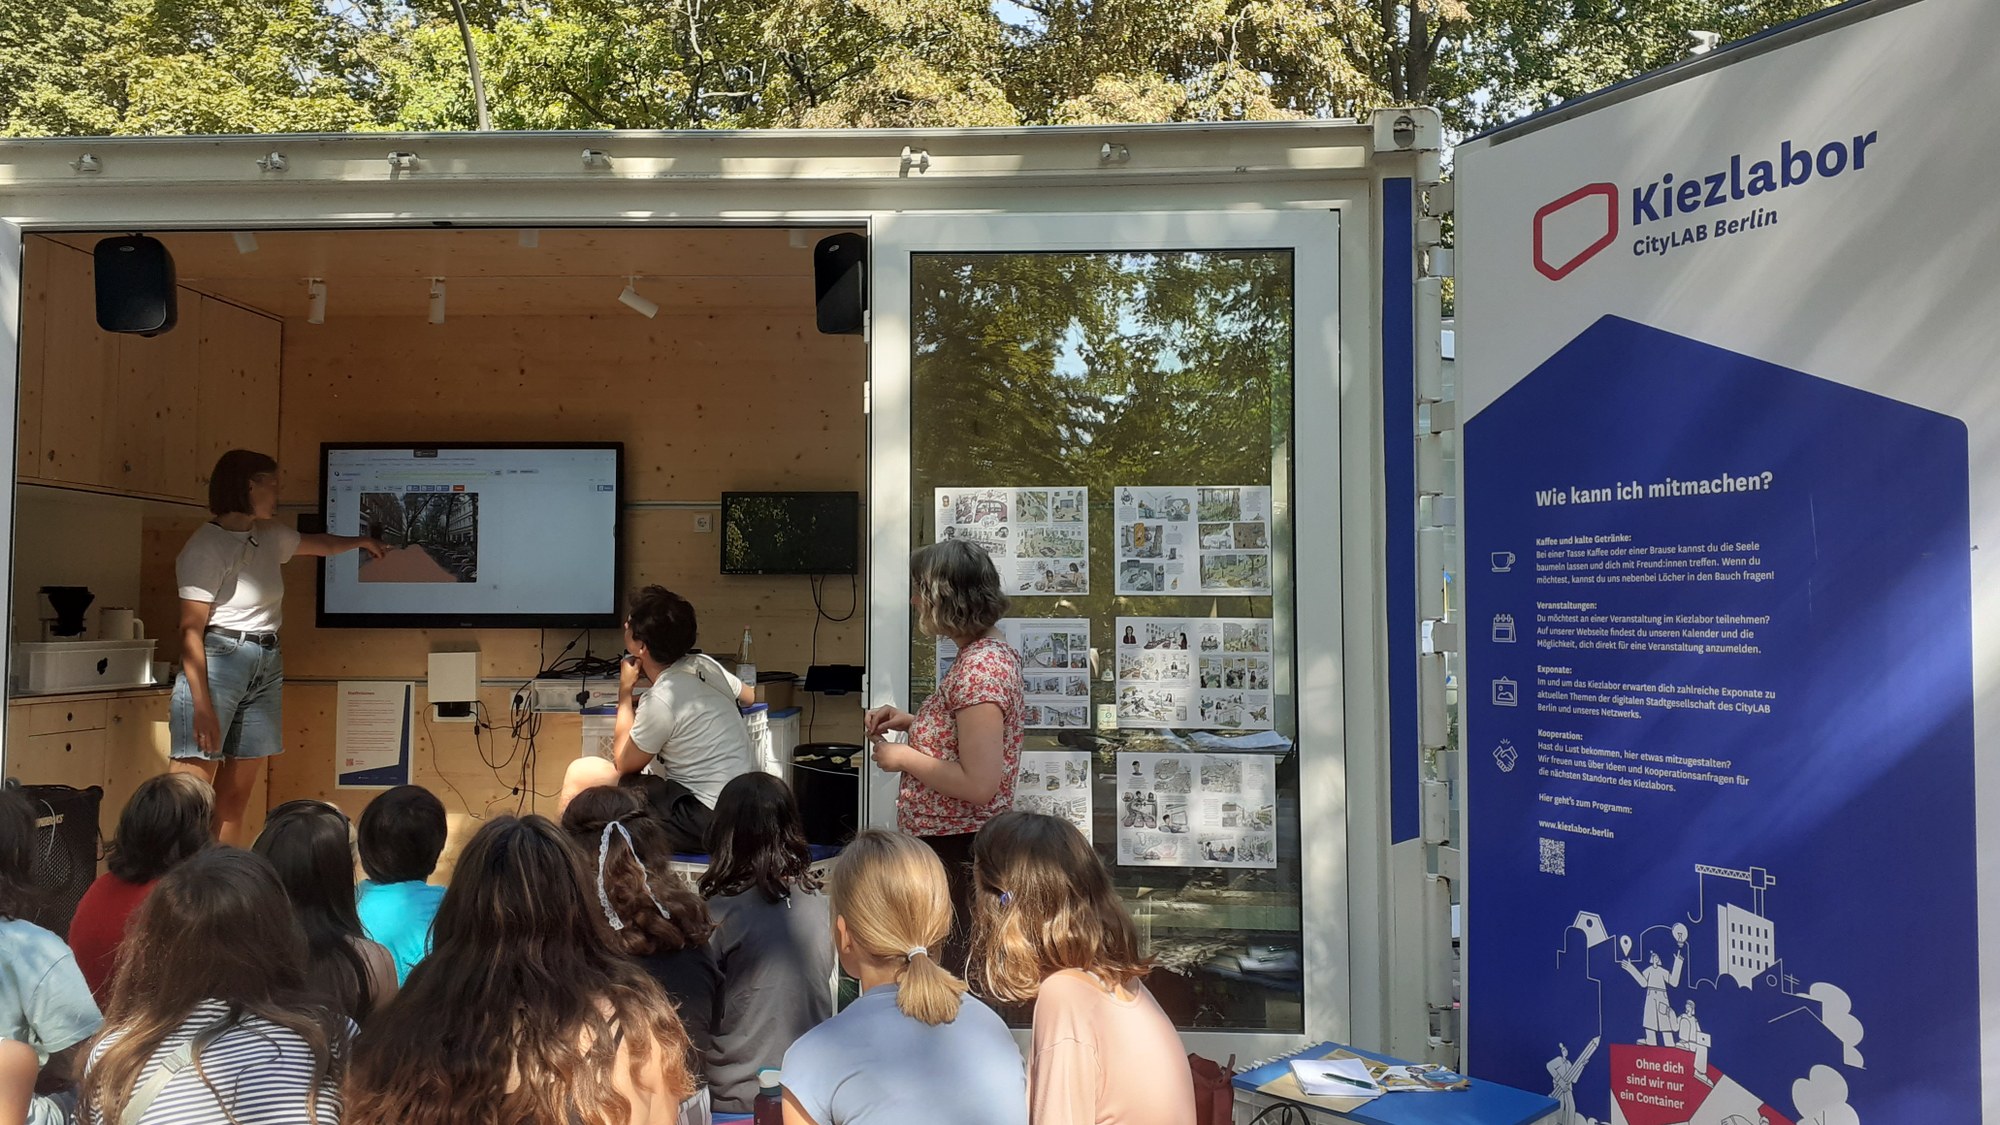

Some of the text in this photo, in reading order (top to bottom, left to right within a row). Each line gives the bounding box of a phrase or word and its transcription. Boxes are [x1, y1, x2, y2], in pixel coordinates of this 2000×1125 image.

[1632, 130, 1878, 226] Kiezlabor
[1632, 207, 1778, 256] CityLAB Berlin
[1536, 471, 1773, 506] Wie kann ich mitmachen?
[1536, 533, 1631, 546] Kaffee und kalte Getränke:
[1536, 550, 1546, 559] Bei
[1548, 550, 1565, 558] einer
[1587, 547, 1608, 556] Kaffee
[1610, 547, 1627, 556] oder
[1628, 546, 1648, 555] einer
[1650, 546, 1676, 554] Brause
[1678, 544, 1705, 553] kannst
[1707, 542, 1718, 552] du
[1720, 542, 1734, 552] die
[1736, 541, 1760, 551] Seele
[1536, 556, 1760, 571] baumeln lassen und dich mit Freund:innen treffen. Wenn du
[1537, 575, 1570, 584] möchtest,
[1572, 575, 1595, 583] kannst
[1596, 574, 1605, 583] du
[1622, 572, 1656, 582] nebenbei
[1658, 573, 1685, 582] Löcher
[1687, 572, 1695, 581] in
[1697, 572, 1712, 581] den
[1715, 571, 1741, 580] Bauch
[1743, 570, 1774, 582] fragen!
[1536, 601, 1597, 611] Veranstaltungen:
[1537, 614, 1546, 622] Du
[1547, 614, 1579, 623] möchtest
[1590, 614, 1608, 623] einer
[1610, 614, 1662, 626] Veranstaltung
[1664, 614, 1673, 623] im
[1676, 614, 1714, 624] Kiezlabor
[1715, 614, 1770, 624] teilnehmen?
[1537, 627, 1548, 635] Auf
[1576, 627, 1609, 636] Webseite
[1610, 627, 1636, 637] findest
[1637, 628, 1647, 637] du
[1682, 628, 1719, 638] Kalender
[1721, 629, 1738, 638] und
[1740, 629, 1754, 639] die
[1537, 639, 1761, 655] Möglichkeit, dich direkt für eine Veranstaltung anzumelden.
[1537, 665, 1572, 675] Exponate:
[1547, 678, 1560, 687] und
[1574, 679, 1586, 688] das
[1588, 680, 1621, 690] Kiezlabor
[1622, 683, 1656, 692] erwarten
[1658, 683, 1675, 693] dich
[1677, 685, 1719, 696] zahlreiche
[1722, 687, 1763, 699] Exponate
[1765, 691, 1775, 699] zu
[1537, 690, 1770, 715] aktuellen Themen der digitalen Stadtgesellschaft des CityLAB
[1538, 703, 1641, 719] Berlin und unseres Netzwerks.
[1538, 729, 1583, 740] Kooperation:
[1538, 742, 1731, 769] Hast du Lust bekommen, hier etwas mitzugestalten?
[1538, 754, 1550, 763] Wir
[1551, 755, 1573, 766] freuen
[1574, 760, 1587, 768] uns
[1587, 759, 1604, 770] über
[1628, 765, 1643, 774] und
[1644, 766, 1734, 785] Kooperationsanfragen
[1736, 775, 1749, 786] für
[1539, 767, 1676, 792] die nächsten Standorte des Kiezlabors.
[1539, 793, 1553, 802] Hier
[1576, 800, 1590, 808] zum
[1592, 801, 1632, 814] Programm:
[1539, 820, 1614, 838] www.kiezlabor.berlin
[1636, 1058, 1684, 1074] Ohne dich
[1627, 1073, 1684, 1091] sind wir nur
[1620, 1090, 1684, 1109] ein Container
